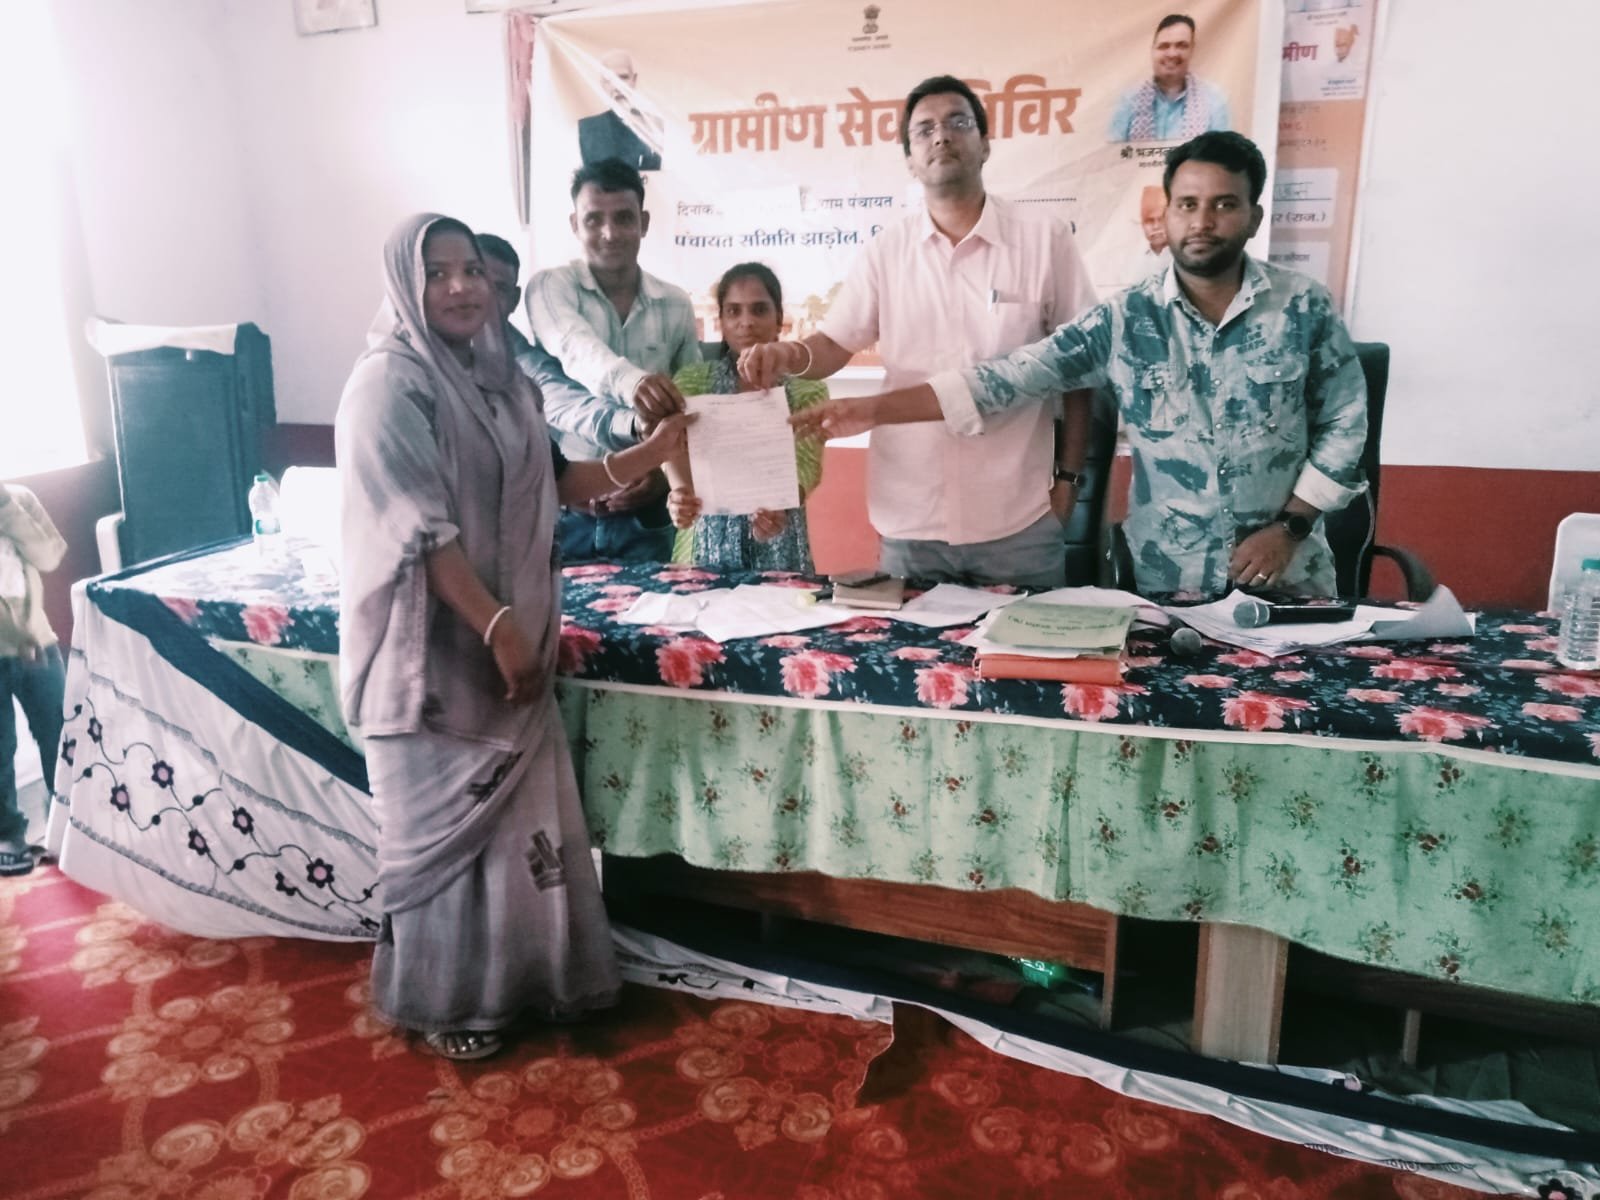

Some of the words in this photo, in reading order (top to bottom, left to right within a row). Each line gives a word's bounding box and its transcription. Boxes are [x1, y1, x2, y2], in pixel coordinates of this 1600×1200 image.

[688, 92, 828, 155] ग्रामीण
[836, 87, 906, 147] सेव
[847, 193, 893, 208] पंचायत
[675, 231, 733, 248] पंचायत
[739, 227, 796, 247] समिति
